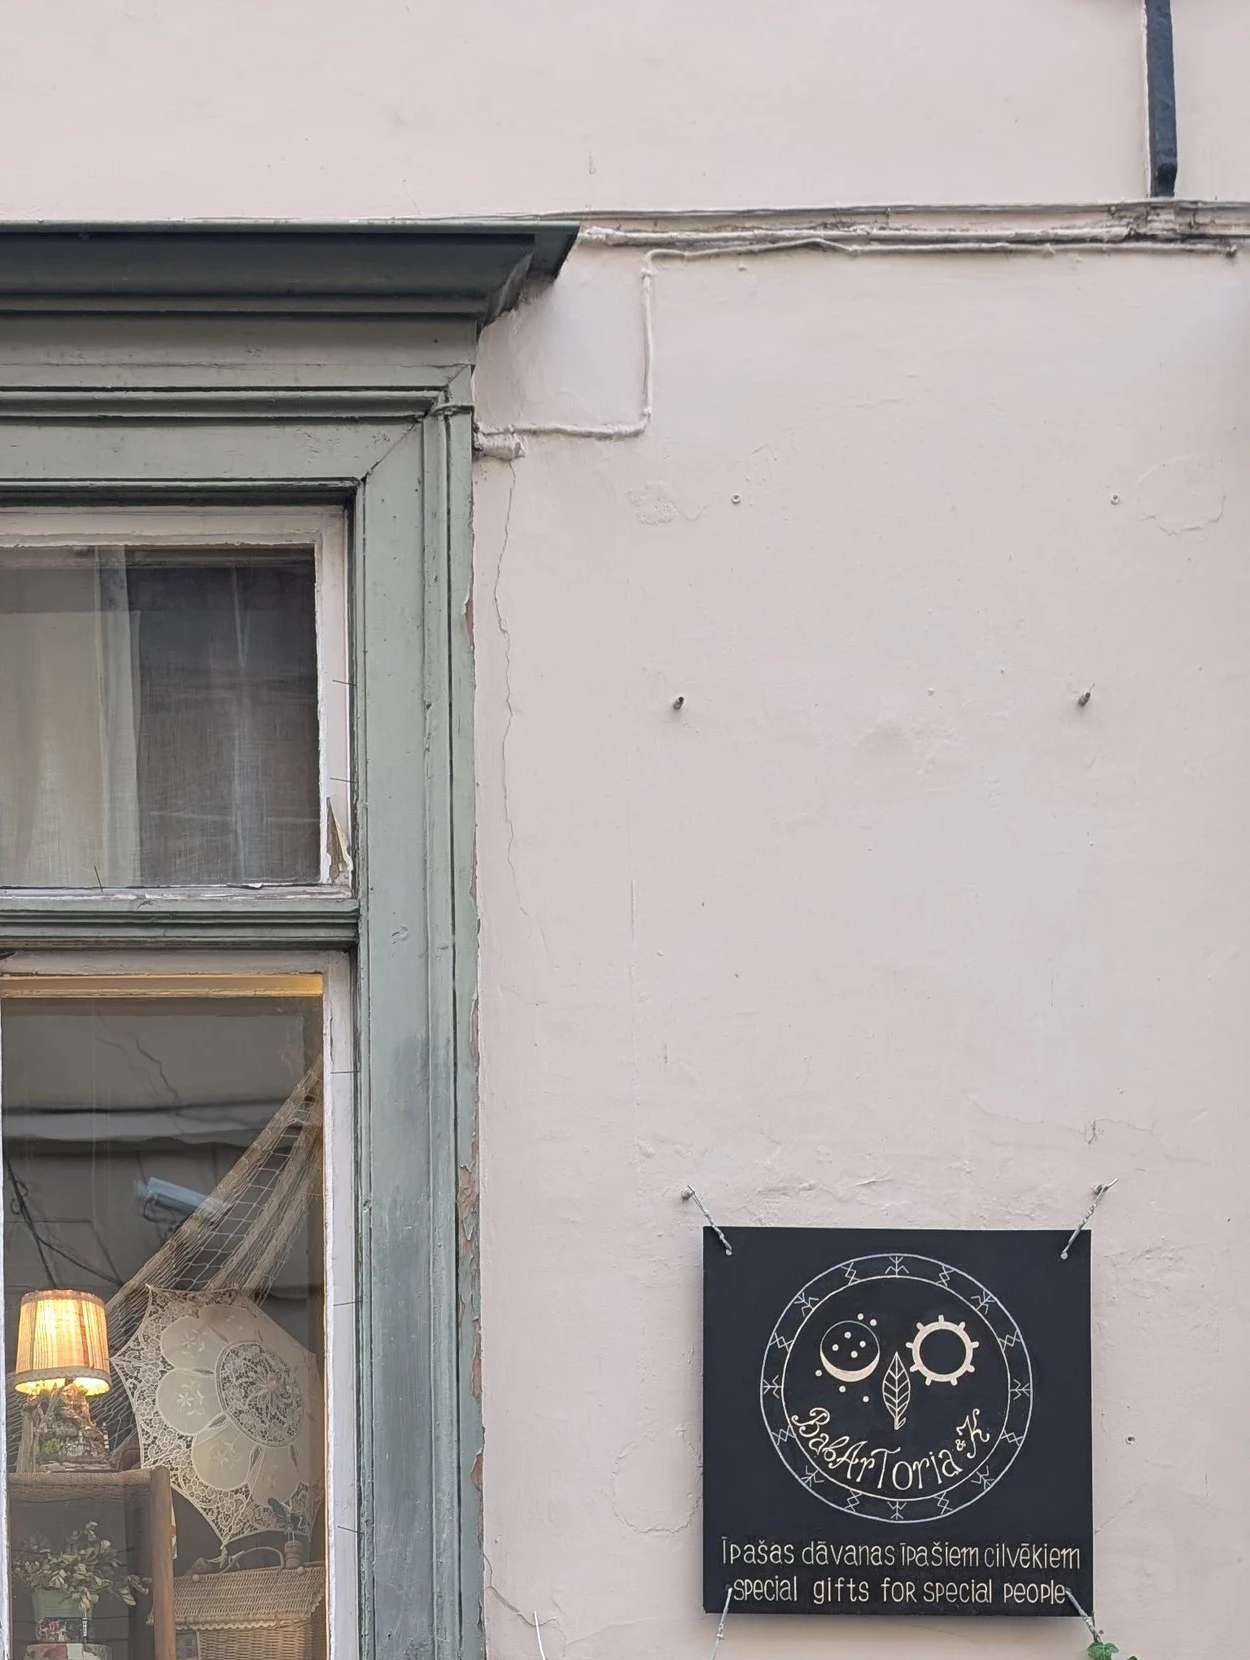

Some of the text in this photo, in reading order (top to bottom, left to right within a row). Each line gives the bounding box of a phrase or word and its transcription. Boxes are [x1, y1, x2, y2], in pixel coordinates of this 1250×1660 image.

[801, 1541, 895, 1567] dāvanas
[984, 1543, 1081, 1570] cilvēkiem
[733, 1575, 797, 1602] special
[813, 1577, 870, 1605] gifts
[923, 1579, 992, 1603] special
[1003, 1579, 1066, 1605] people
